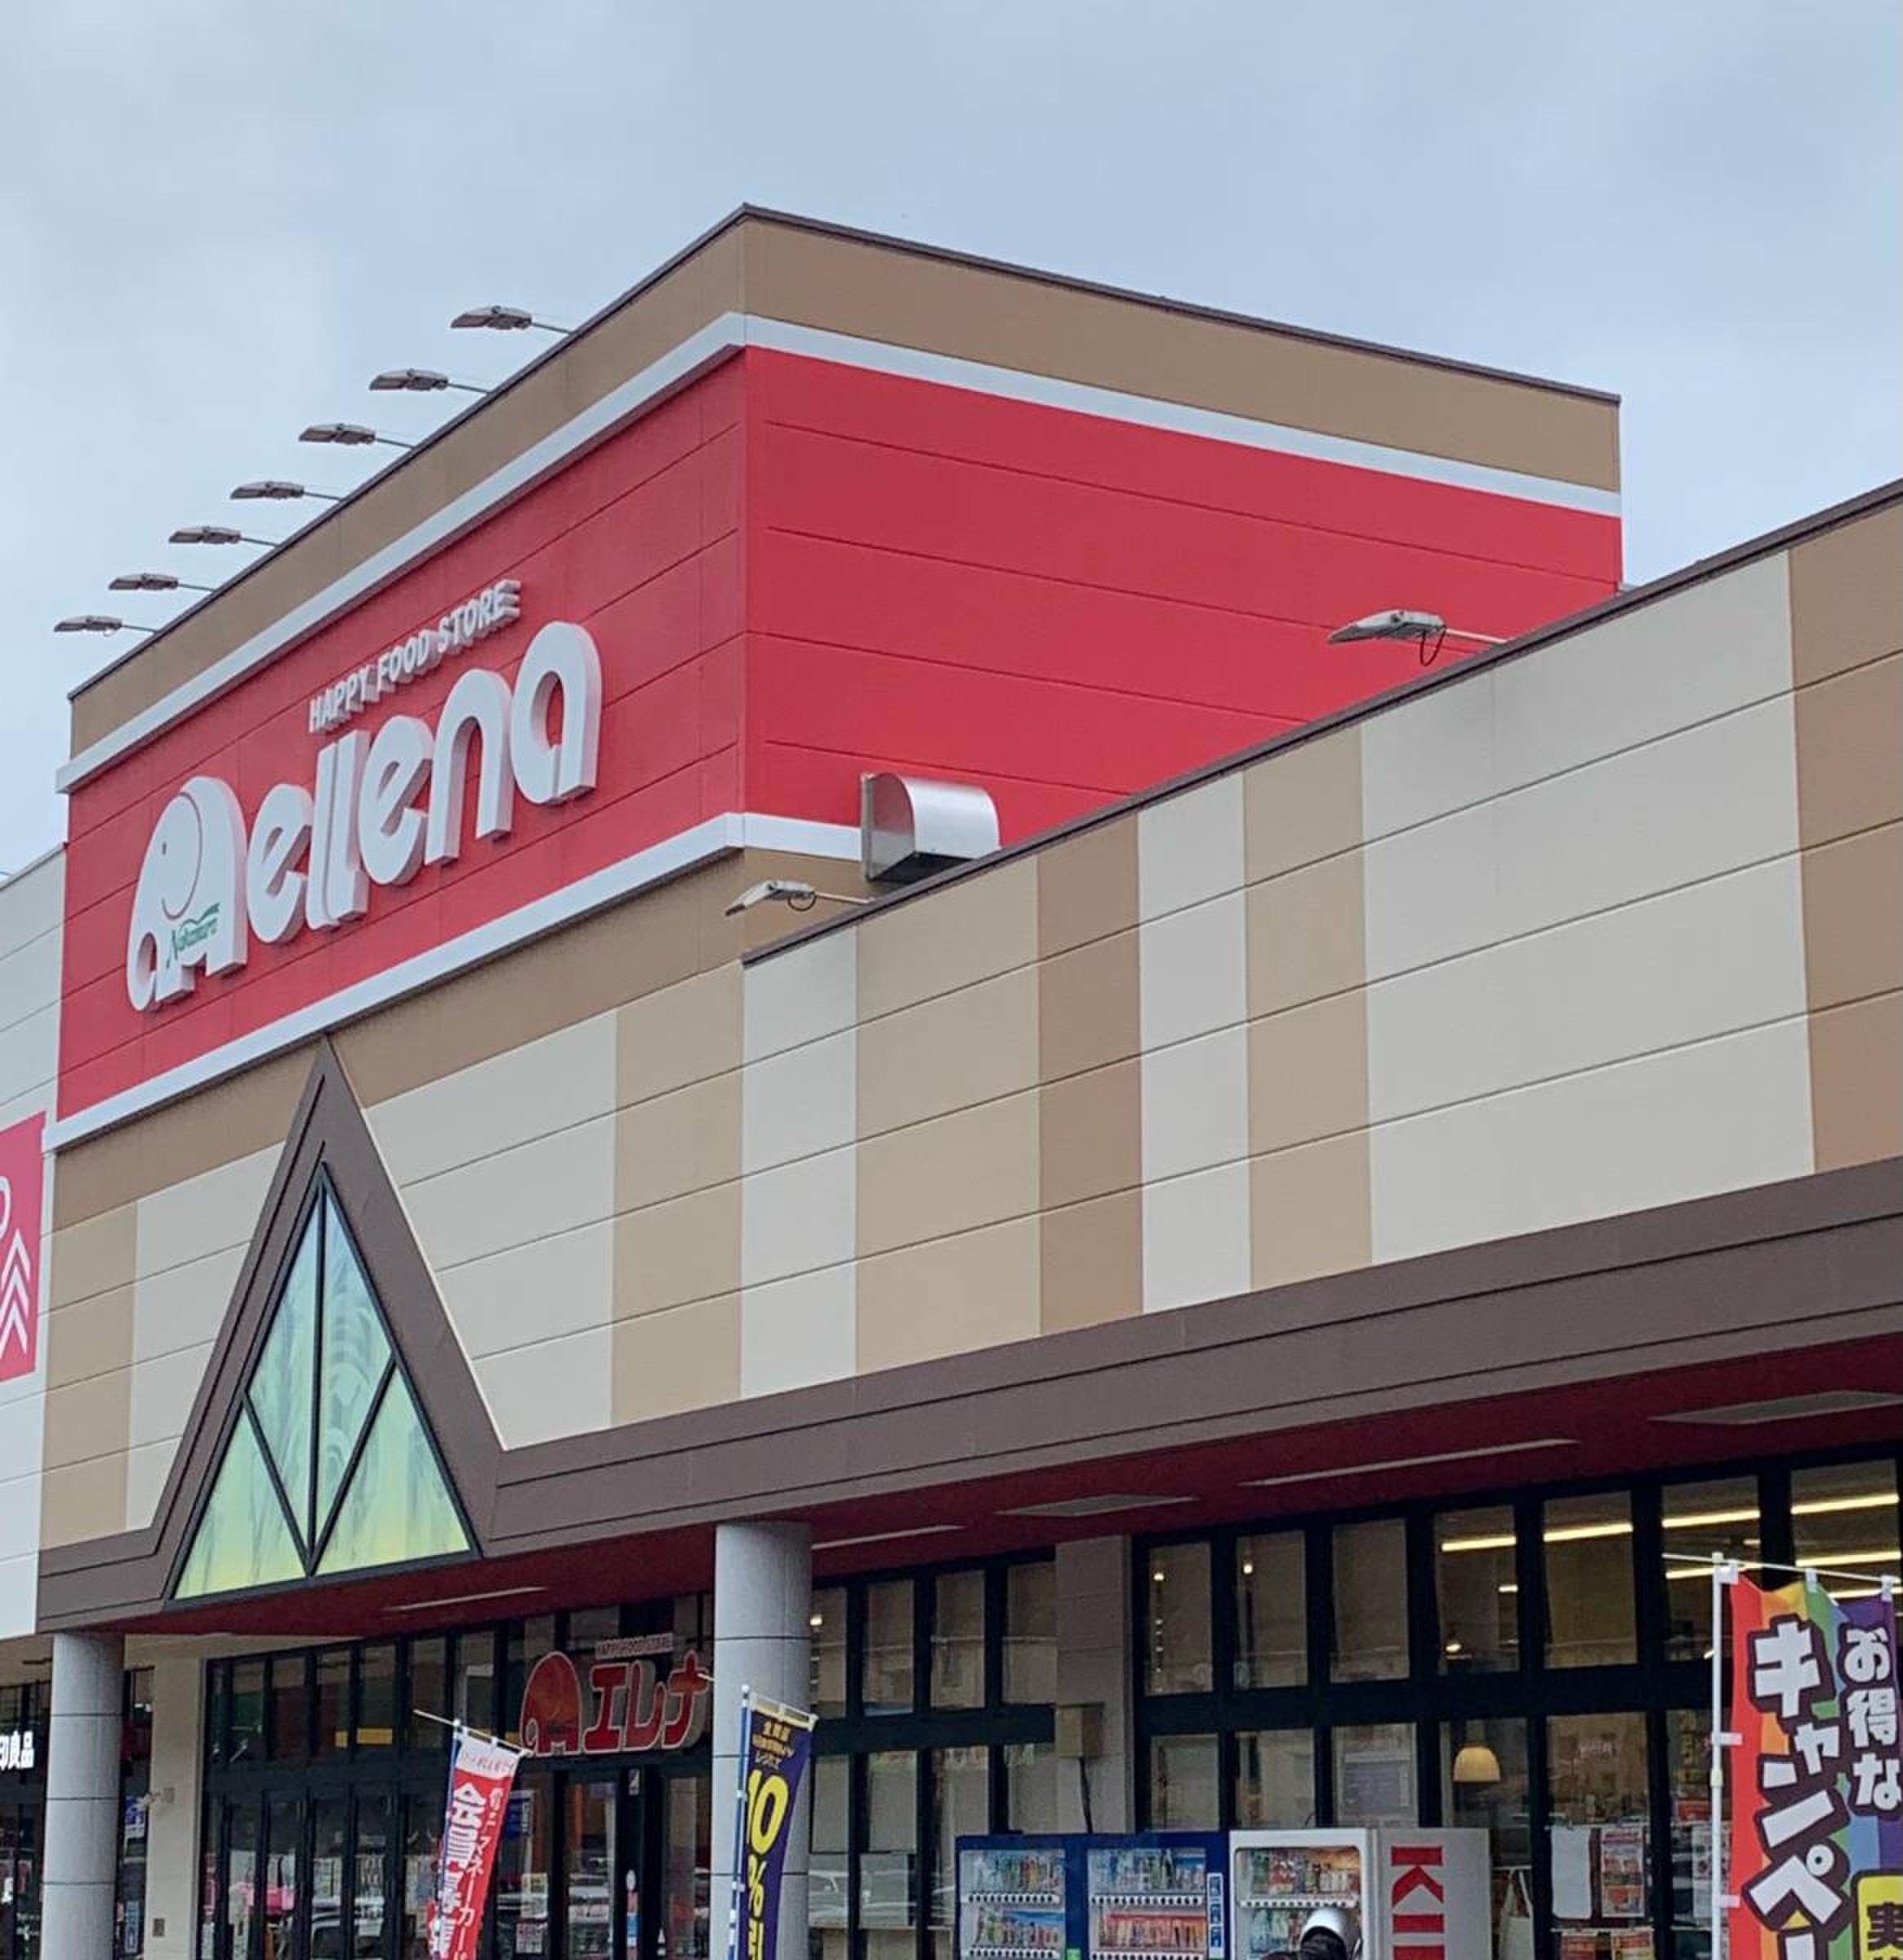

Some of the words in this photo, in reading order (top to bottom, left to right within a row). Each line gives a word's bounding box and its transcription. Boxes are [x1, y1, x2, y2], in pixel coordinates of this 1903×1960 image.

[309, 664, 379, 733] HAPPY
[377, 629, 442, 693] FOOD
[437, 579, 522, 655] STORE
[583, 1649, 711, 1754] エレナ
[1843, 1627, 1902, 1810] お得な
[1391, 1846, 1445, 1960] KI
[1867, 1901, 1903, 1960] 実
